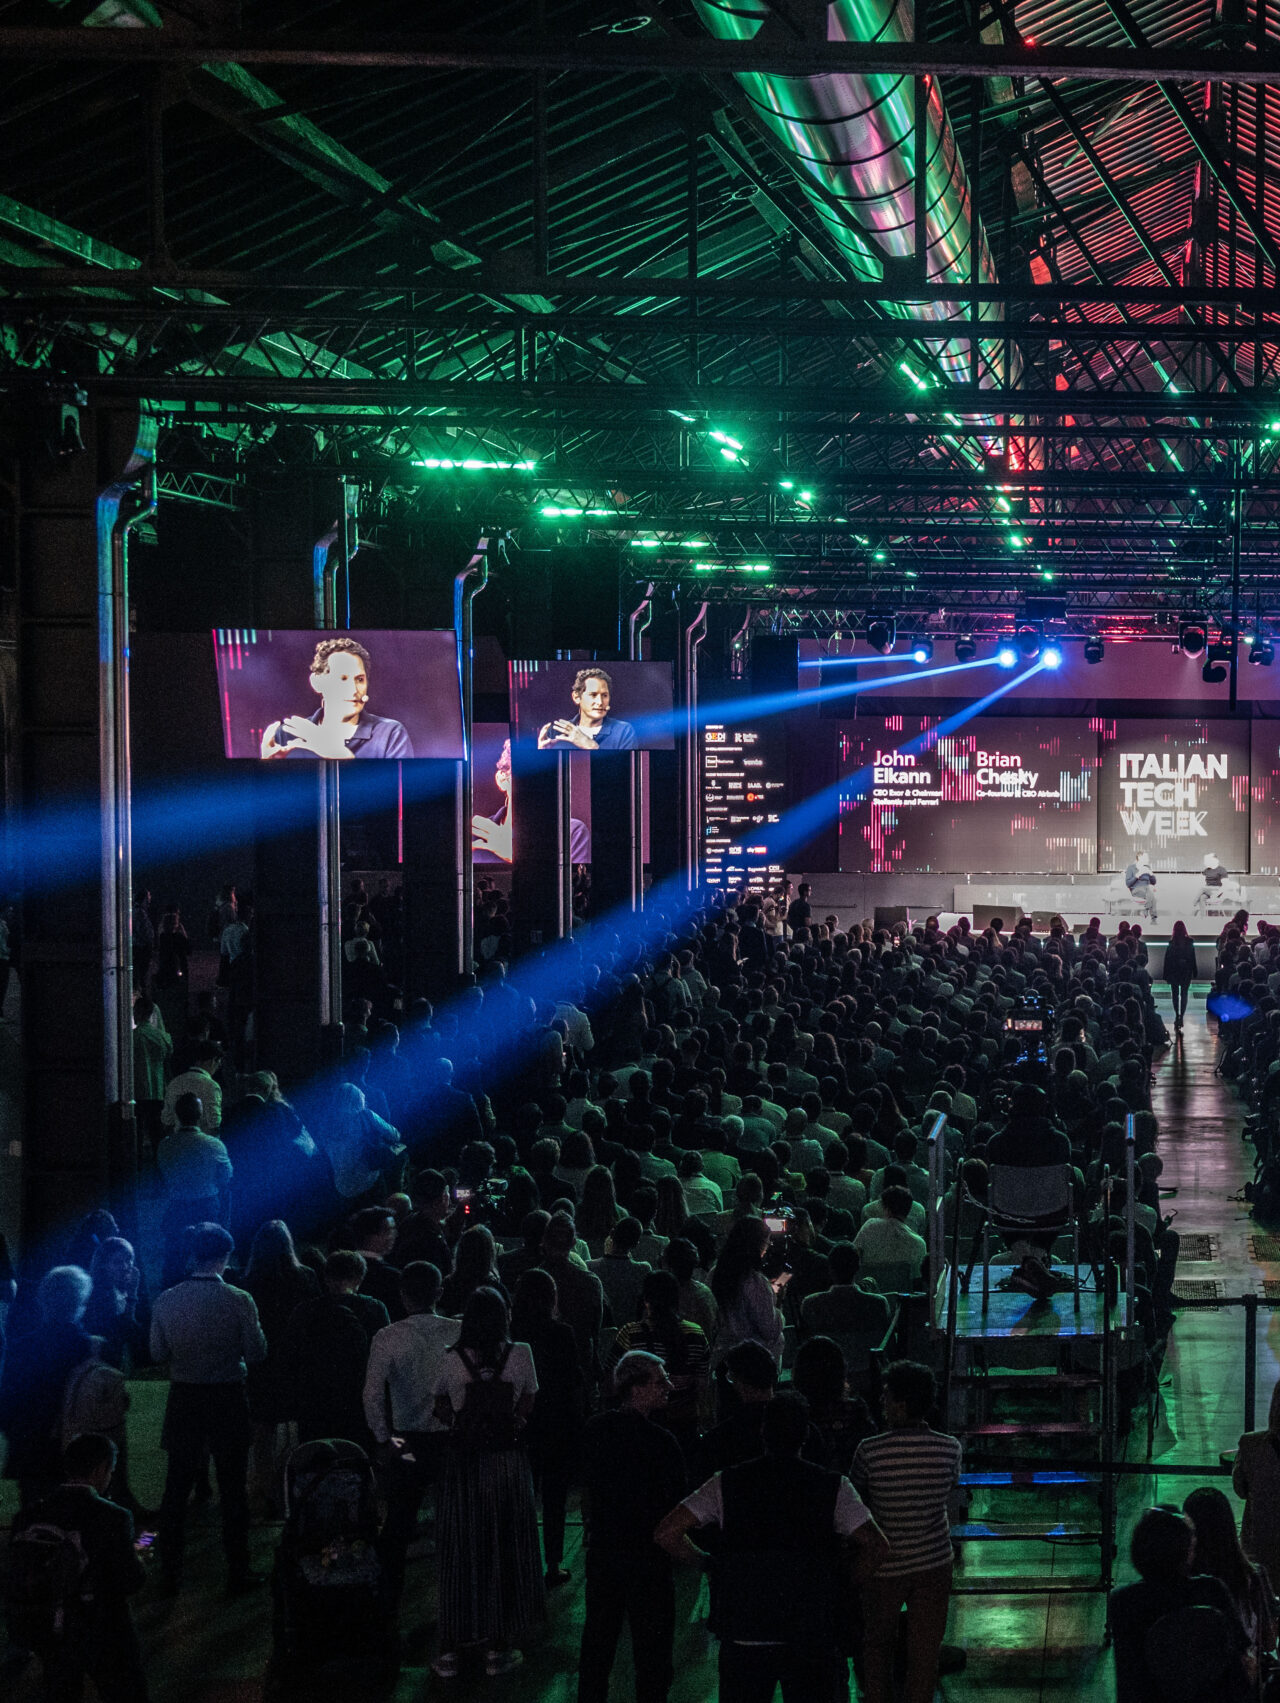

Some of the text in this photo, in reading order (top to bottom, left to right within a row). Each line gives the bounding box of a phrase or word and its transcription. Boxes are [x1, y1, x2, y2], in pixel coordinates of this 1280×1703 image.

[873, 750, 915, 766] John
[977, 751, 1021, 767] Brian
[1120, 754, 1228, 779] ITALIAN
[873, 768, 931, 784] Elkann
[976, 768, 1039, 789] Chesky
[1120, 782, 1197, 808] TECH
[1120, 811, 1208, 836] WEEK
